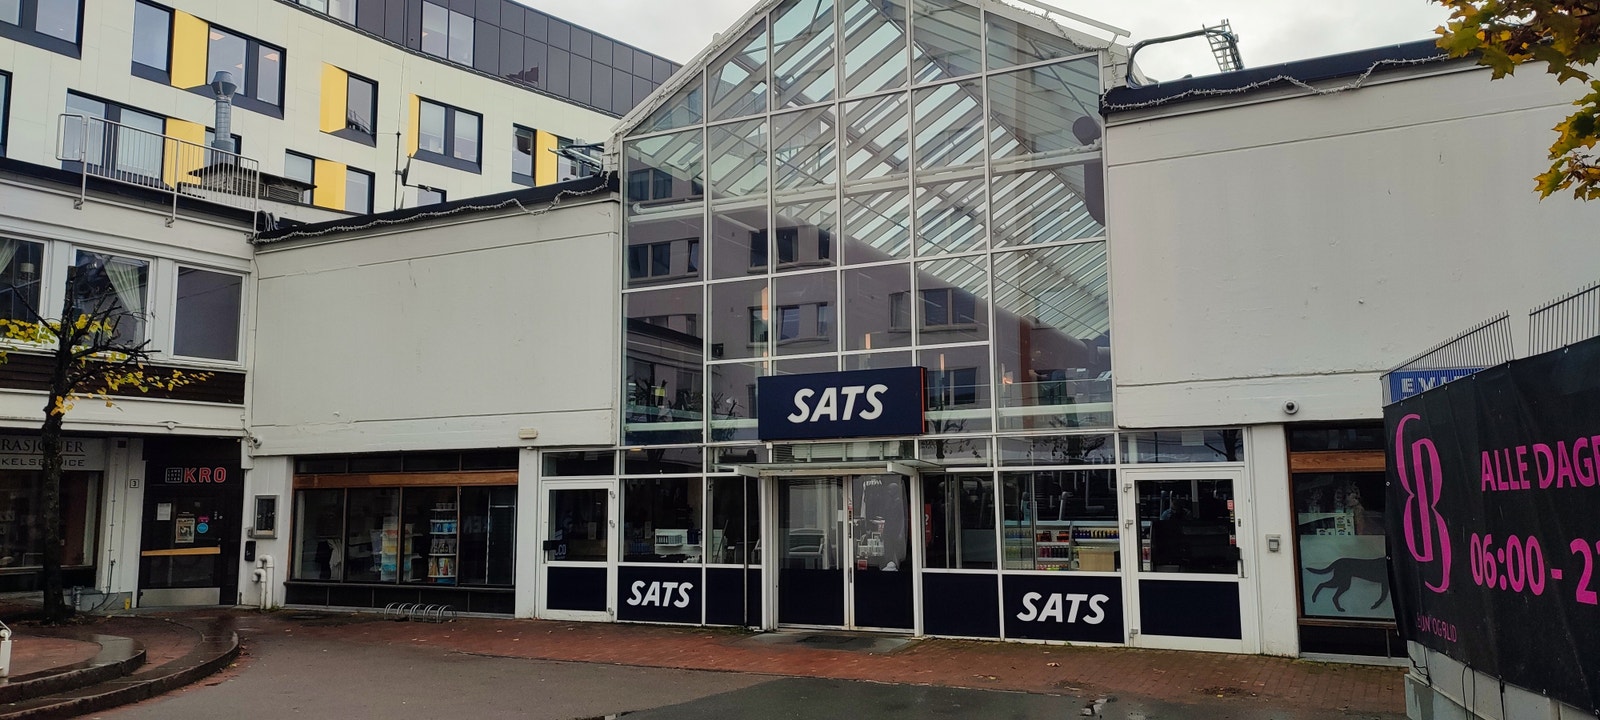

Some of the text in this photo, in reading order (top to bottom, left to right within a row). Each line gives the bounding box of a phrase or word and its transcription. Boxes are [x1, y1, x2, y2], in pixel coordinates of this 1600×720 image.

[787, 384, 888, 424] SATS
[183, 467, 227, 483] KRO
[1481, 446, 1531, 492] ALLE
[1470, 533, 1545, 595] 06:00
[1569, 537, 1600, 605] 2
[627, 581, 693, 608] SATS
[1016, 592, 1109, 625] SATS
